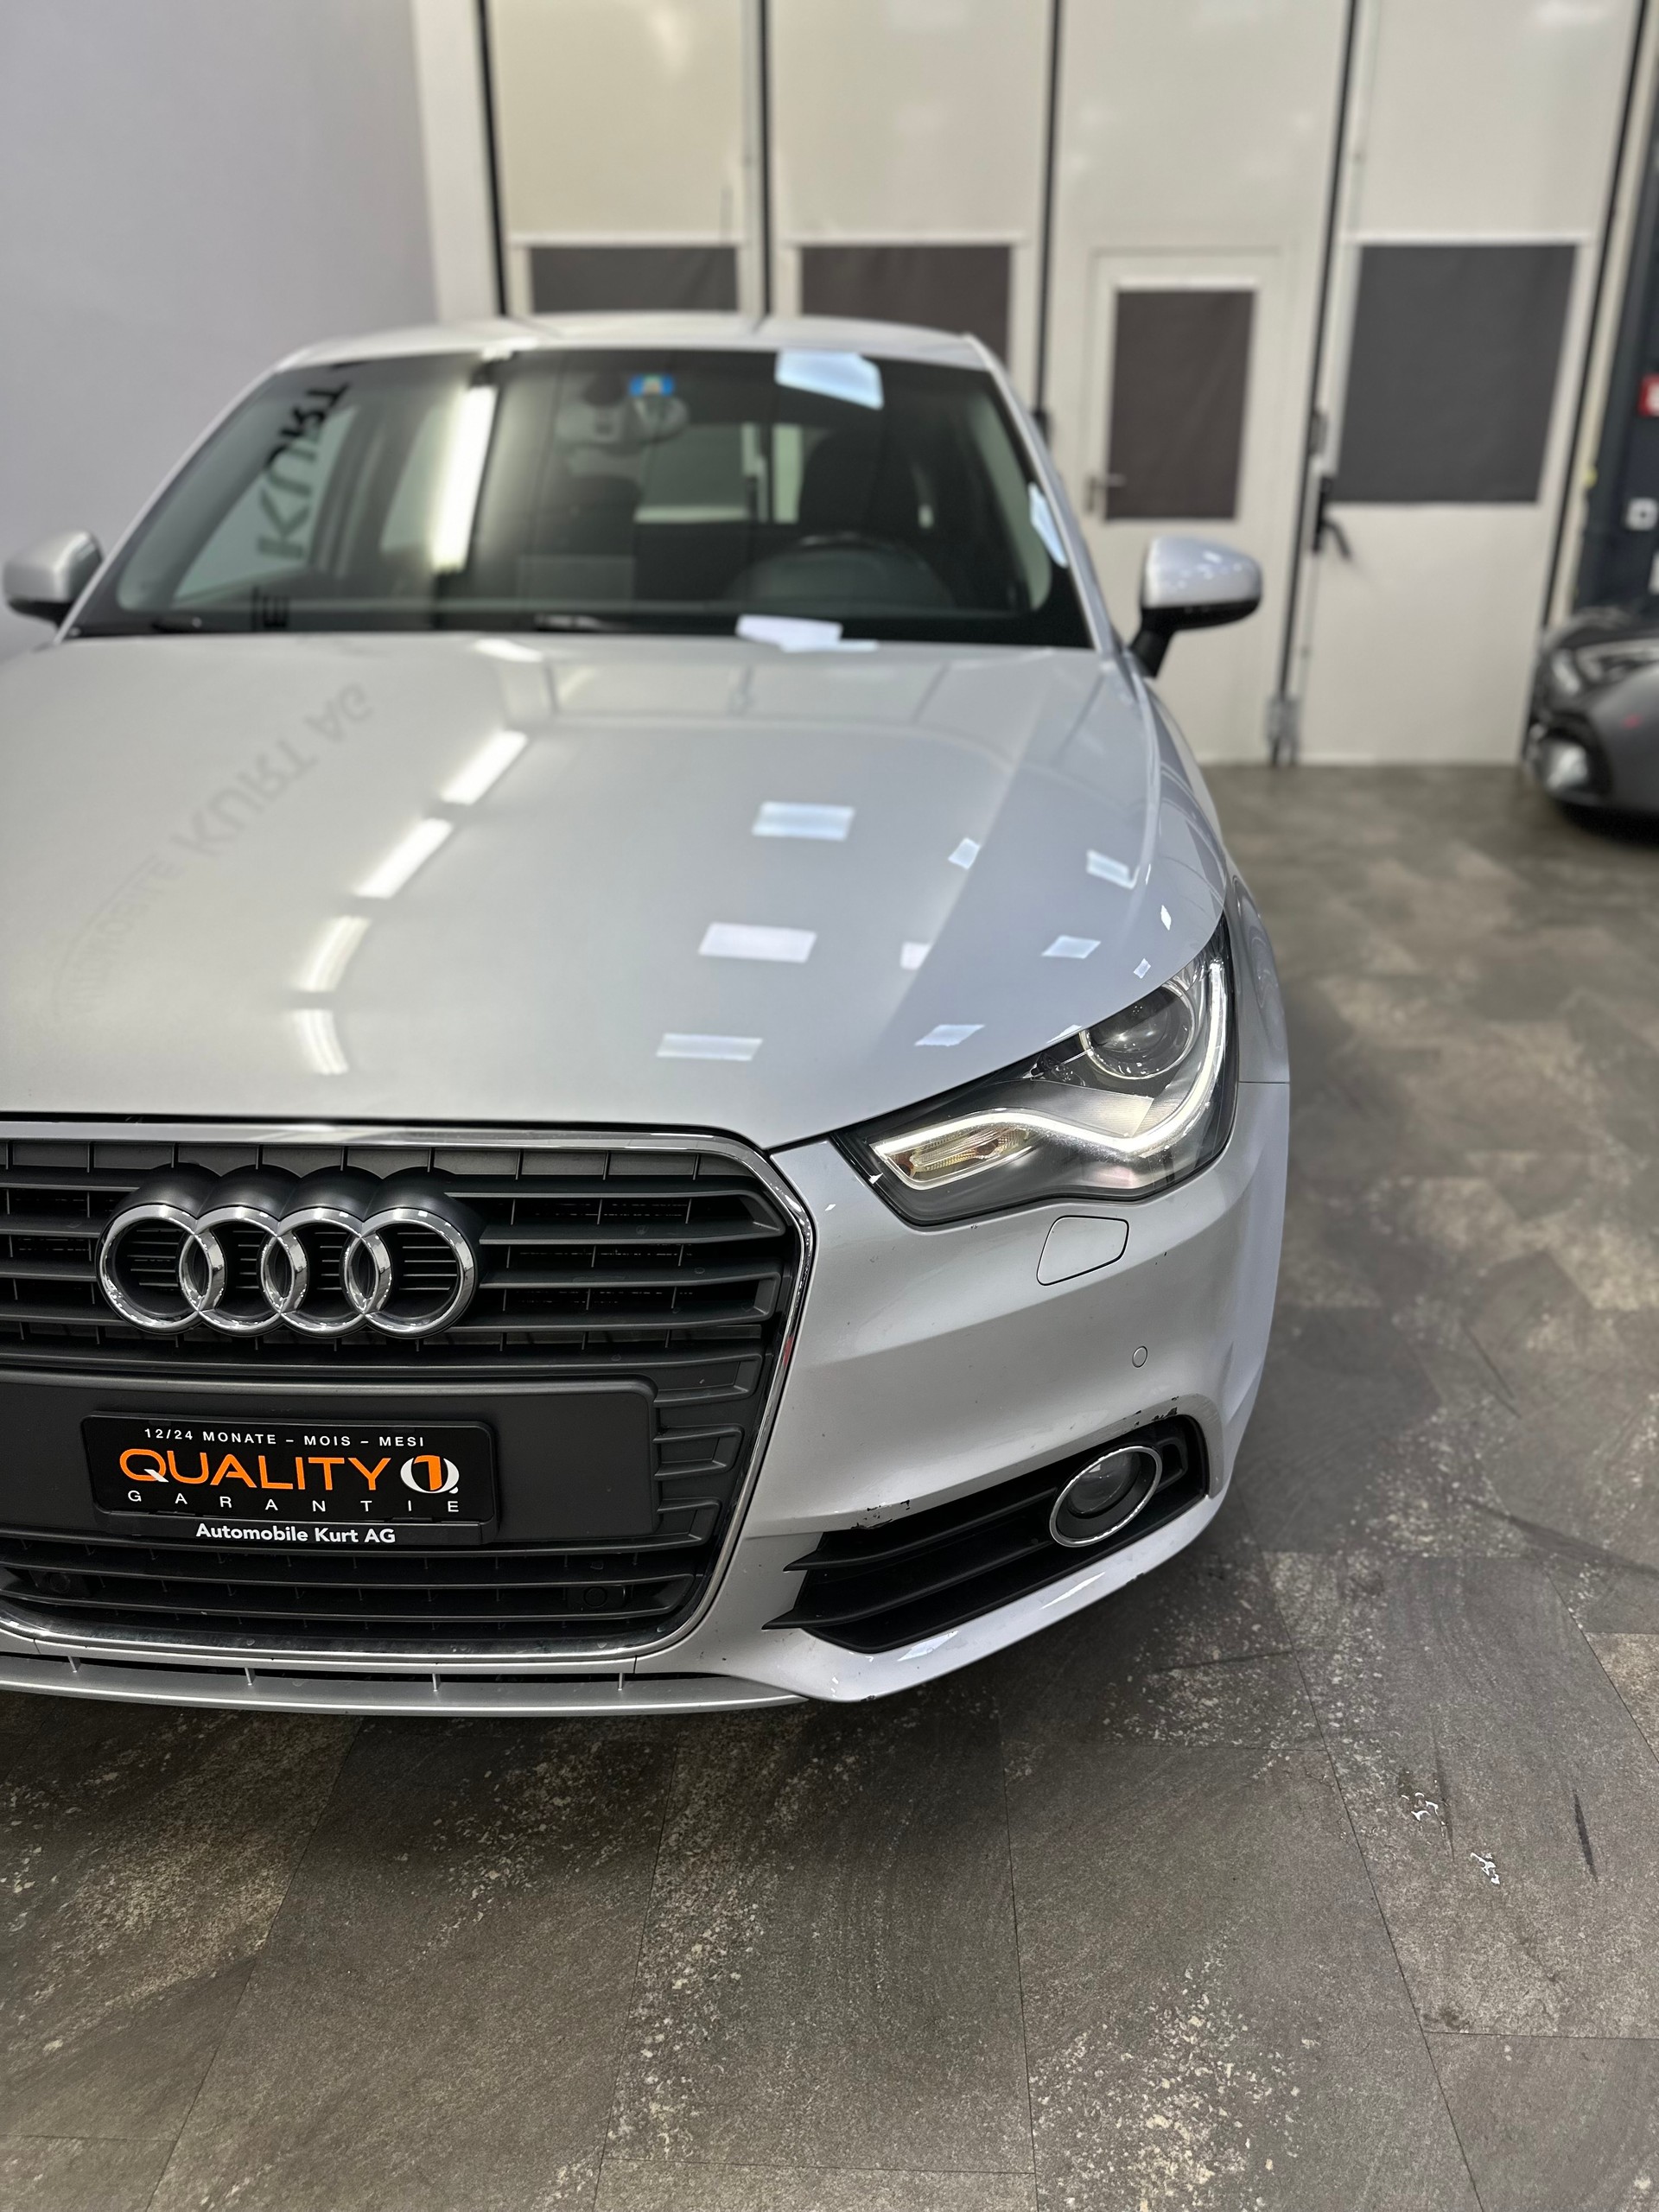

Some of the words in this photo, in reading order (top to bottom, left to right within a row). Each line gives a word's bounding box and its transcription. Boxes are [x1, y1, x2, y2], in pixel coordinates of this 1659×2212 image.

[144, 1427, 194, 1440] 12/24
[202, 1431, 276, 1445] MONATE
[303, 1435, 351, 1446] MOIS
[378, 1436, 424, 1447] MESI
[118, 1448, 391, 1491] QUALITY
[127, 1490, 460, 1513] GARANTIE
[195, 1522, 308, 1541] Automobile
[314, 1527, 359, 1543] Kurt
[364, 1528, 396, 1543] AG
